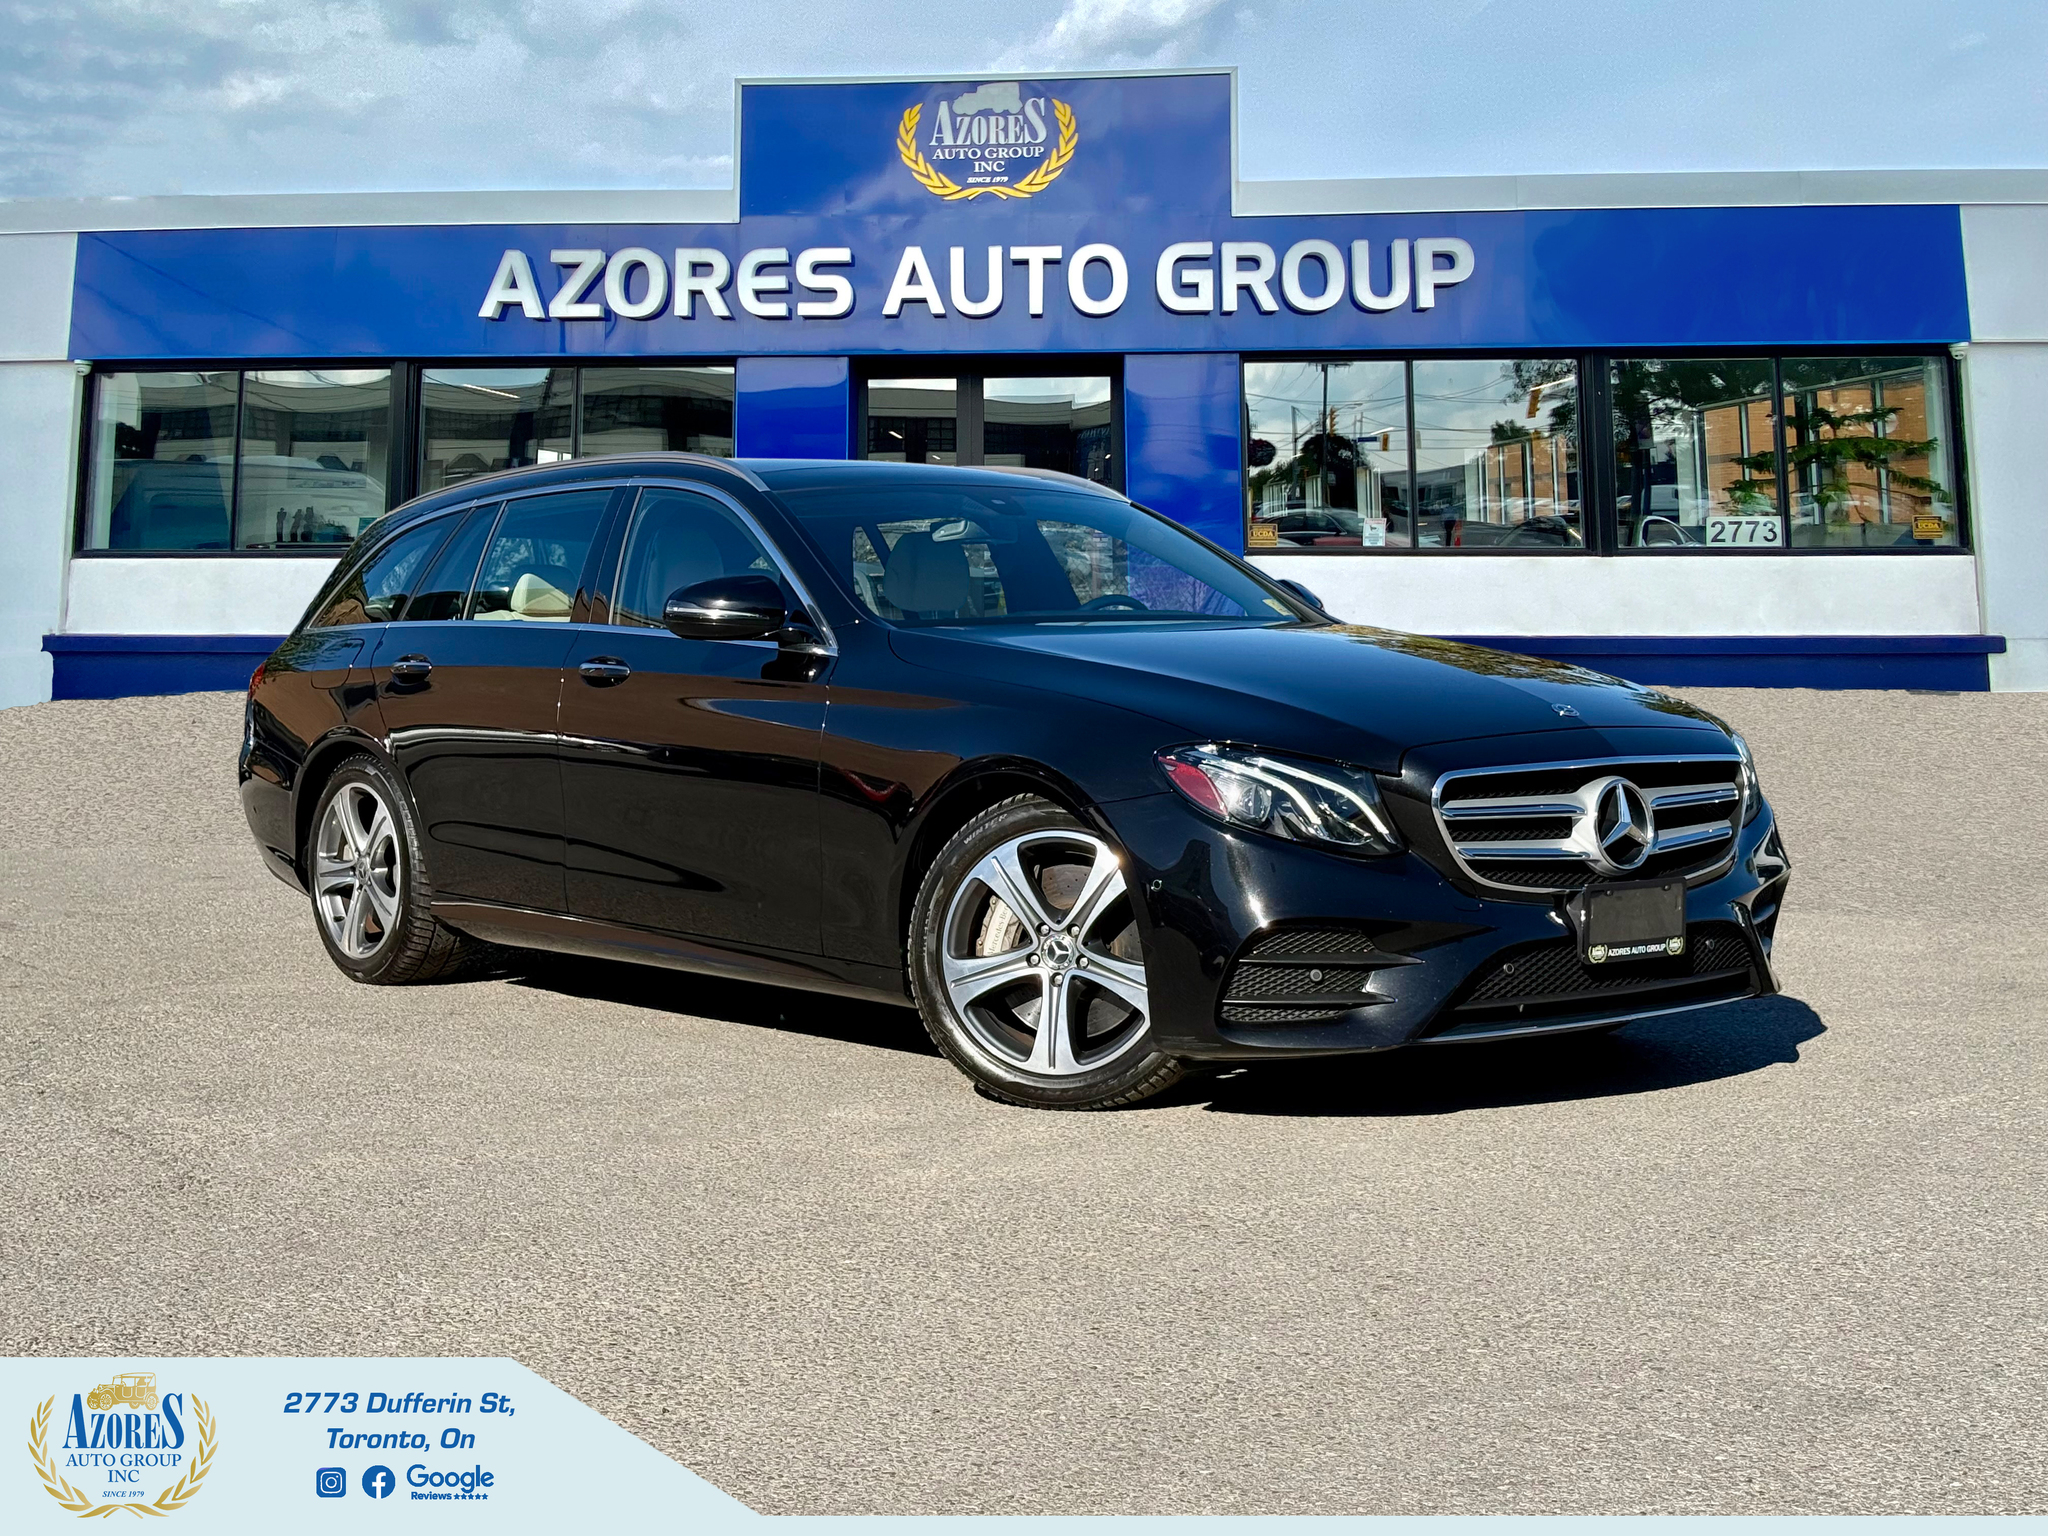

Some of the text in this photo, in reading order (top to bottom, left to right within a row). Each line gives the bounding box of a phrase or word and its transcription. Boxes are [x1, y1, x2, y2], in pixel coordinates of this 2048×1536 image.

[929, 97, 1047, 146] AZORES
[932, 146, 1045, 160] AUTO GROUP
[973, 160, 1005, 173] INC
[966, 176, 992, 184] SINCE
[478, 237, 1475, 319] AZORES AUTO GROUP
[1711, 520, 1778, 543] 2773
[963, 813, 1008, 845] WINTER
[1608, 947, 1631, 957] AZORES
[1631, 945, 1646, 954] AUTO
[1646, 943, 1666, 953] GROUP
